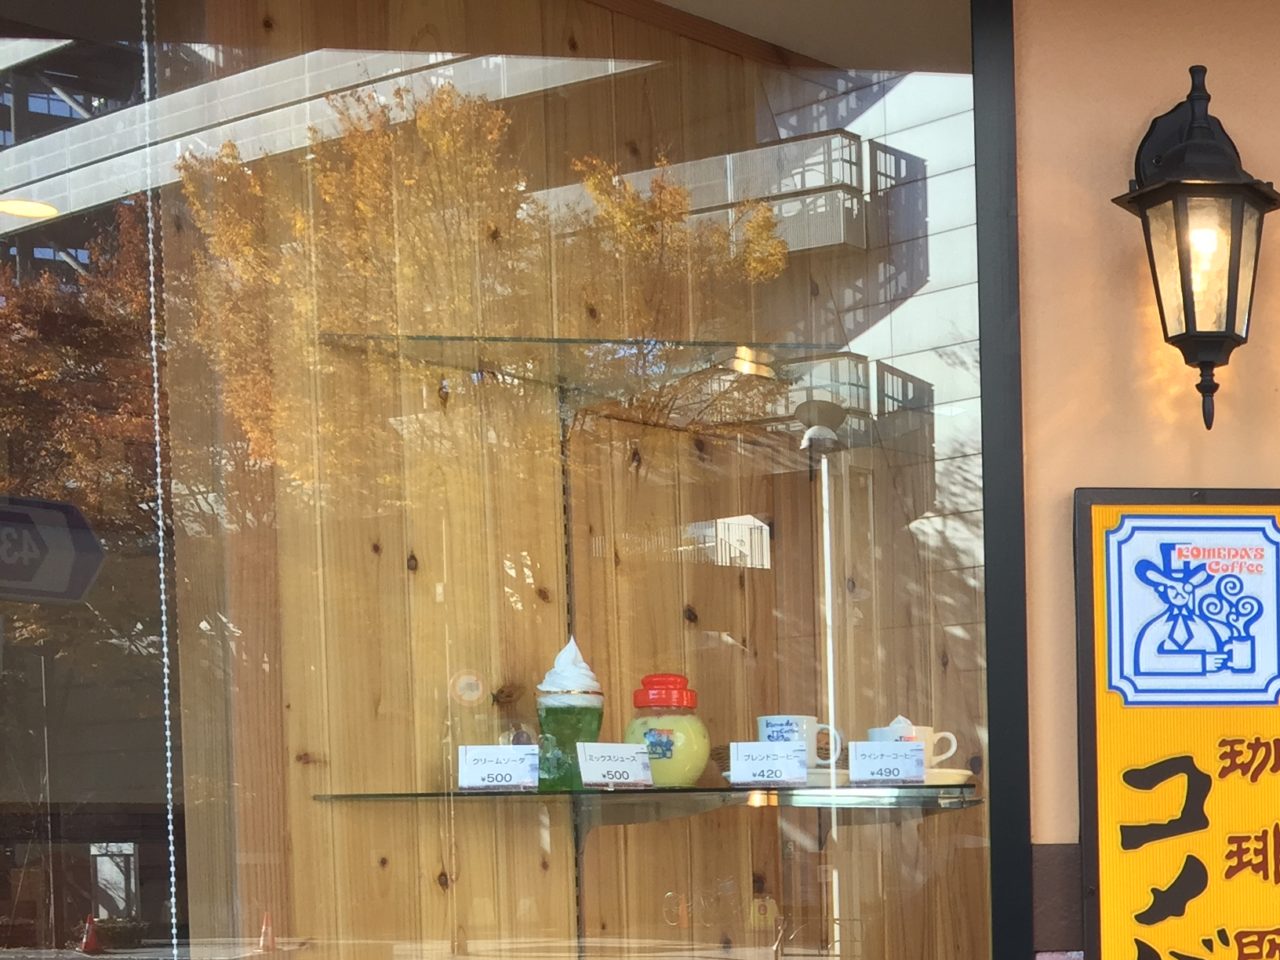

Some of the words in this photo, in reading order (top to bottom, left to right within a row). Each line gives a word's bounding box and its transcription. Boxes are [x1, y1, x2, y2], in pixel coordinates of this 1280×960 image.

[1177, 546, 1265, 560] KOMEDA'S
[1206, 560, 1264, 574] Coffee
[472, 757, 526, 766] クリームソーダ
[588, 753, 637, 762] ミックスジュース
[744, 753, 801, 762] ブレンドコーヒー
